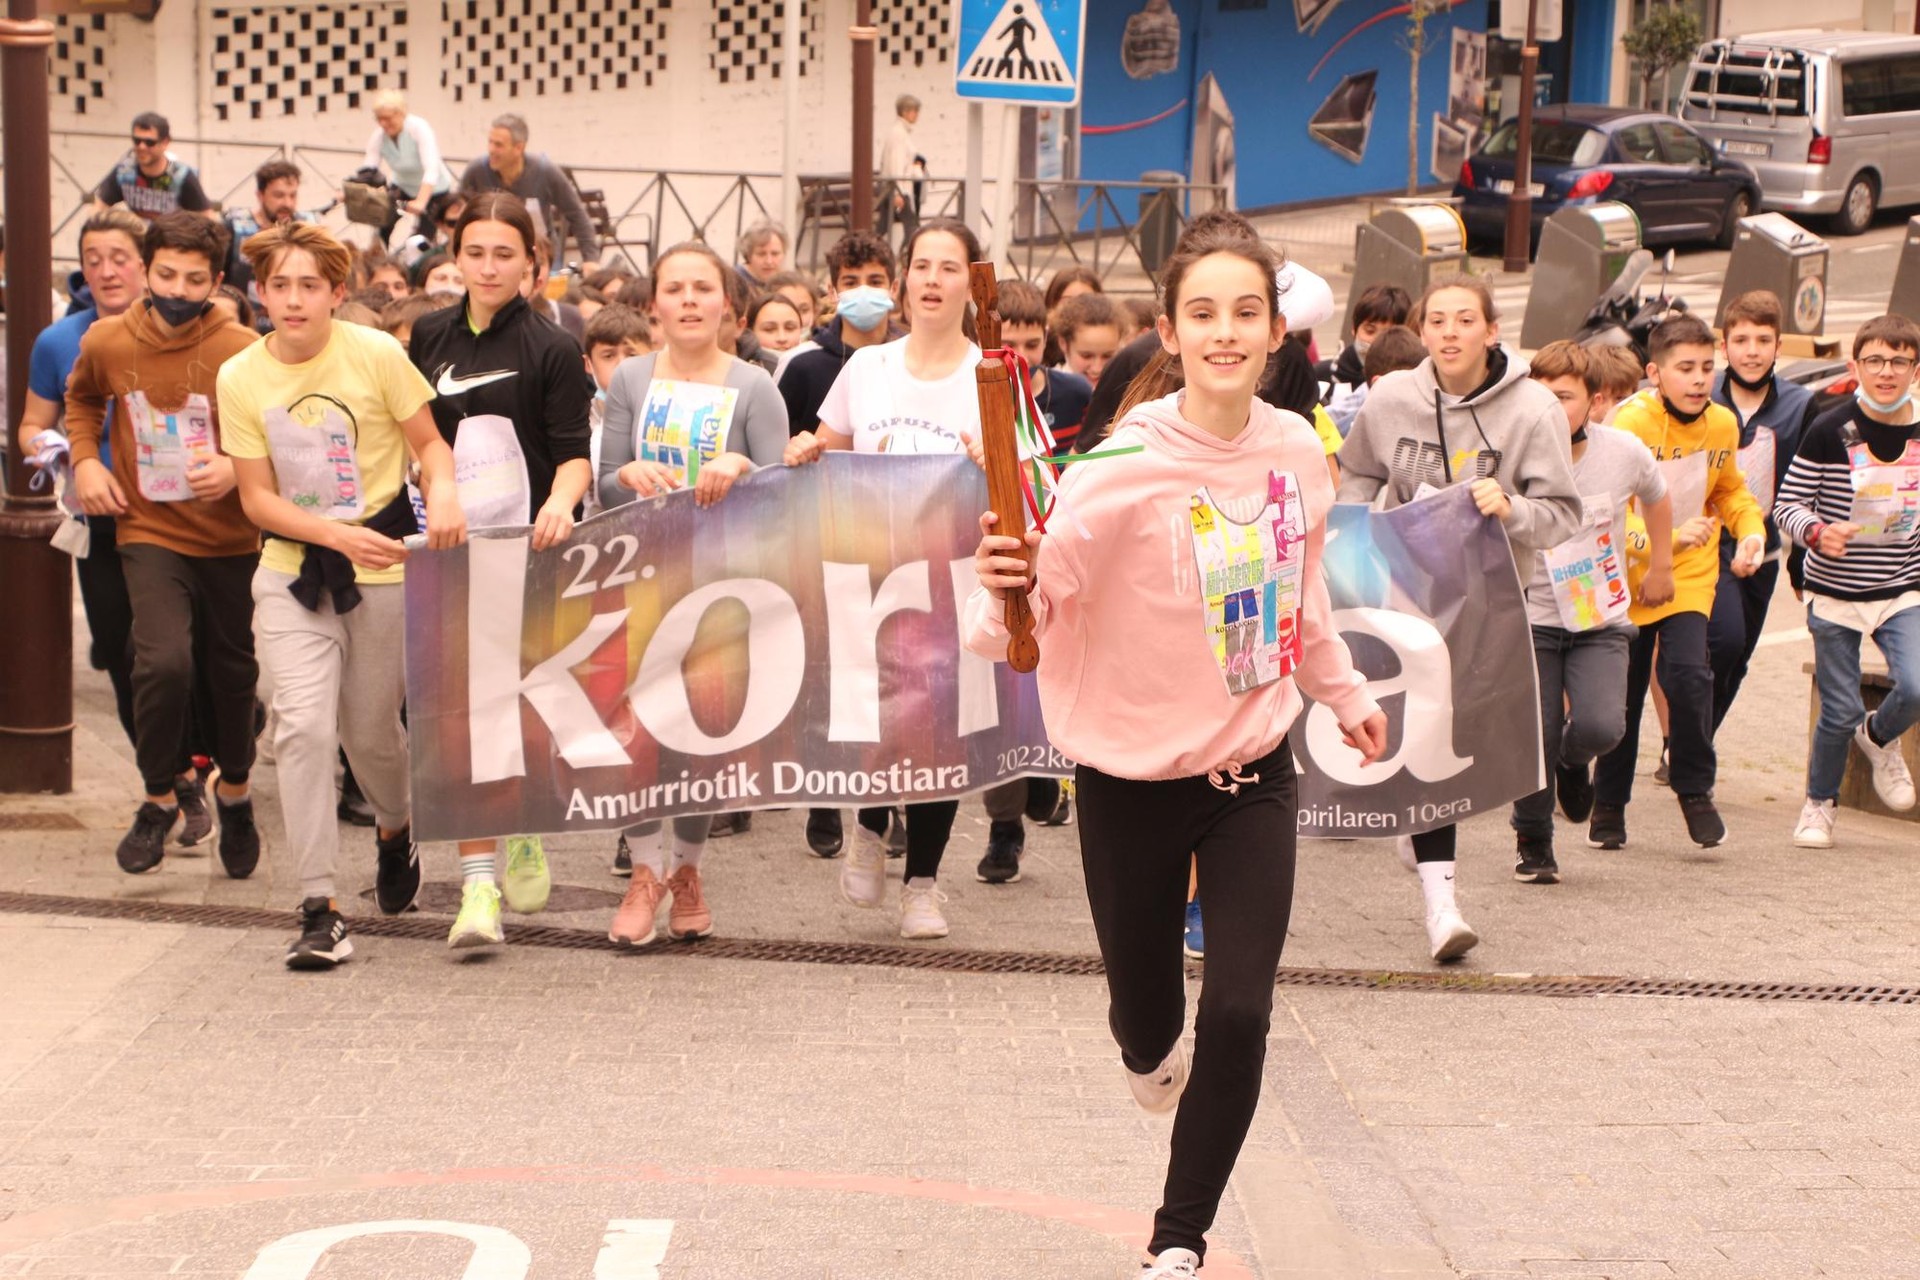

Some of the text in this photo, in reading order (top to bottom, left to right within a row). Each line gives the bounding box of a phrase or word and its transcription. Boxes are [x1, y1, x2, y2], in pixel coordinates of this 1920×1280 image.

[326, 433, 357, 508] korrika
[561, 533, 656, 599] 22.
[1269, 516, 1298, 664] korrika
[565, 761, 761, 821] Amurriotik
[773, 758, 970, 796] Donostiara
[1406, 797, 1472, 824] 10era
